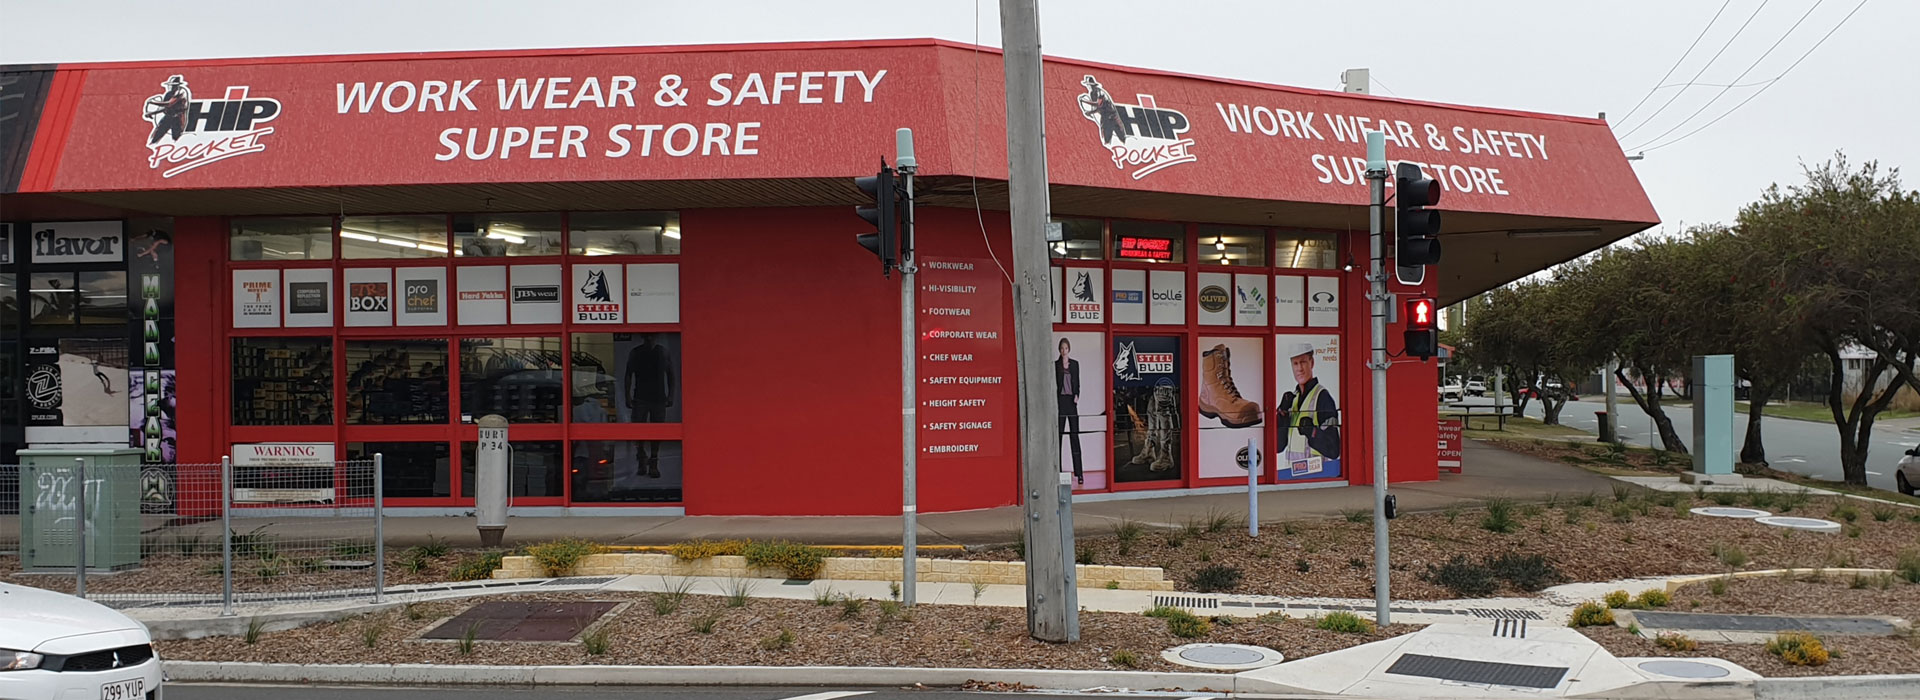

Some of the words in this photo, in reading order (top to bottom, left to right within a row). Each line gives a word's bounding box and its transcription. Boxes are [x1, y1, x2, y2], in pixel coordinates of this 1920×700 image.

[336, 79, 481, 114] WORK
[497, 75, 637, 110] WEAR
[653, 74, 688, 107] &
[706, 70, 887, 106] SAFETY
[185, 88, 278, 132] HIP
[1115, 96, 1188, 140] HIP
[1216, 102, 1325, 140] WORK
[1324, 113, 1420, 148] WEAR
[1424, 123, 1451, 152] &
[1452, 126, 1549, 160] SAFETY
[151, 128, 272, 167] POCKET
[434, 125, 589, 161] SUPER
[605, 122, 761, 158] STORE
[1112, 140, 1194, 168] POCKET
[1312, 154, 1398, 188] SUP
[35, 229, 119, 256] flavor
[1122, 237, 1136, 249] HIP
[1137, 238, 1170, 250] POCKET
[929, 261, 974, 270] WORKWEAR
[408, 285, 428, 296] pro
[929, 285, 976, 293] HI-VISIBILITY
[1152, 289, 1182, 301] bollé
[351, 296, 387, 310] BOX
[408, 295, 435, 306] chef
[929, 308, 970, 316] FOOTWEAR
[929, 330, 973, 339] CORPORATE
[975, 331, 997, 339] WEAR
[1139, 363, 1171, 371] BLUE
[929, 399, 957, 407] HEIGHT
[959, 399, 986, 407] SAFETY
[929, 422, 957, 430] SAFETY
[254, 446, 315, 456] WARNING
[929, 445, 979, 453] EMBROIDERY
